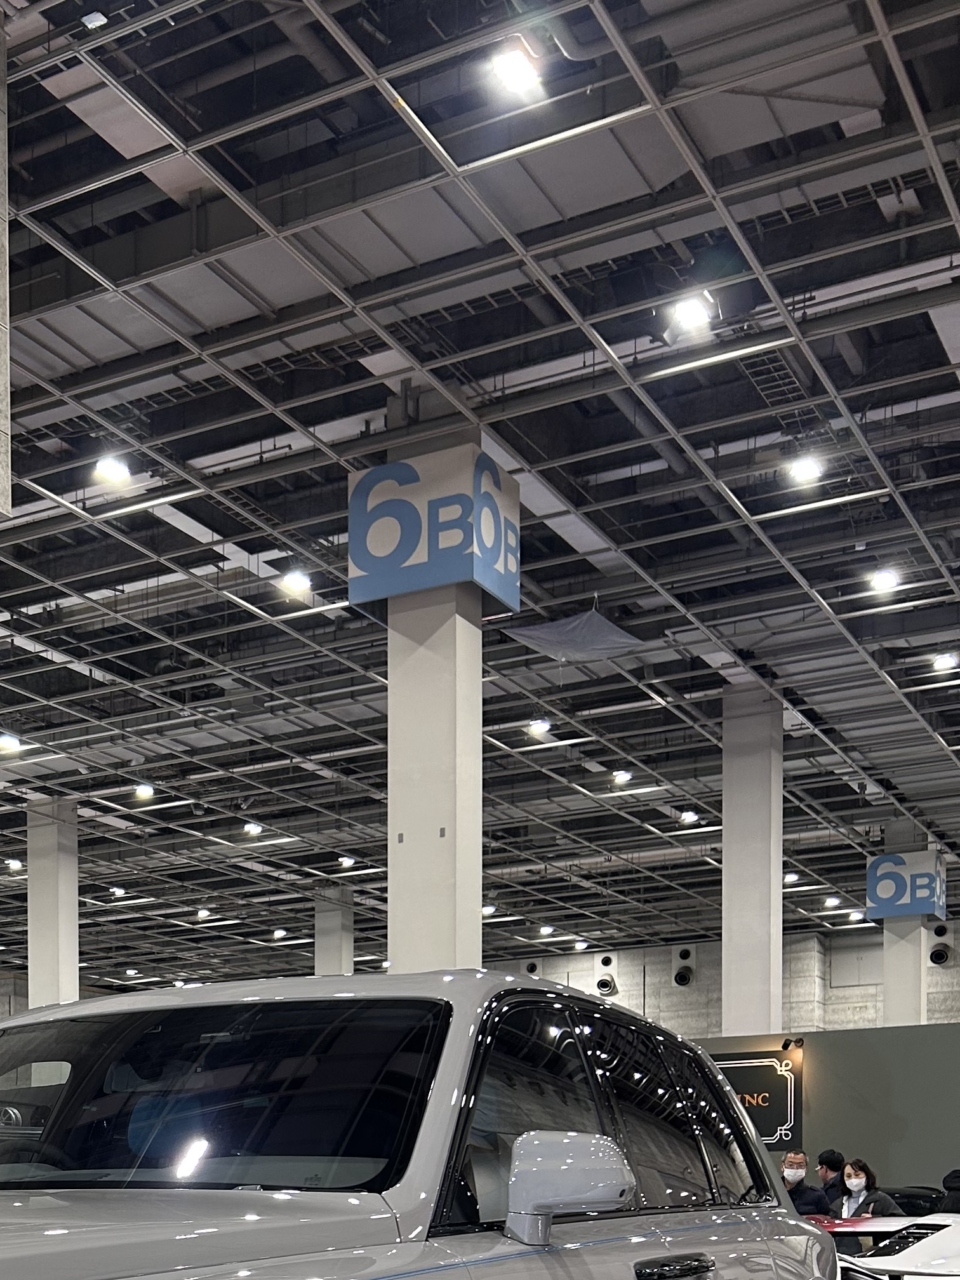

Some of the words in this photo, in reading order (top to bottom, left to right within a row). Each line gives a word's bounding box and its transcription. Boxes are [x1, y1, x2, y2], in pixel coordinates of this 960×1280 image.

[350, 462, 474, 575] 6B
[474, 452, 520, 582] 6B
[867, 854, 935, 906] 6B
